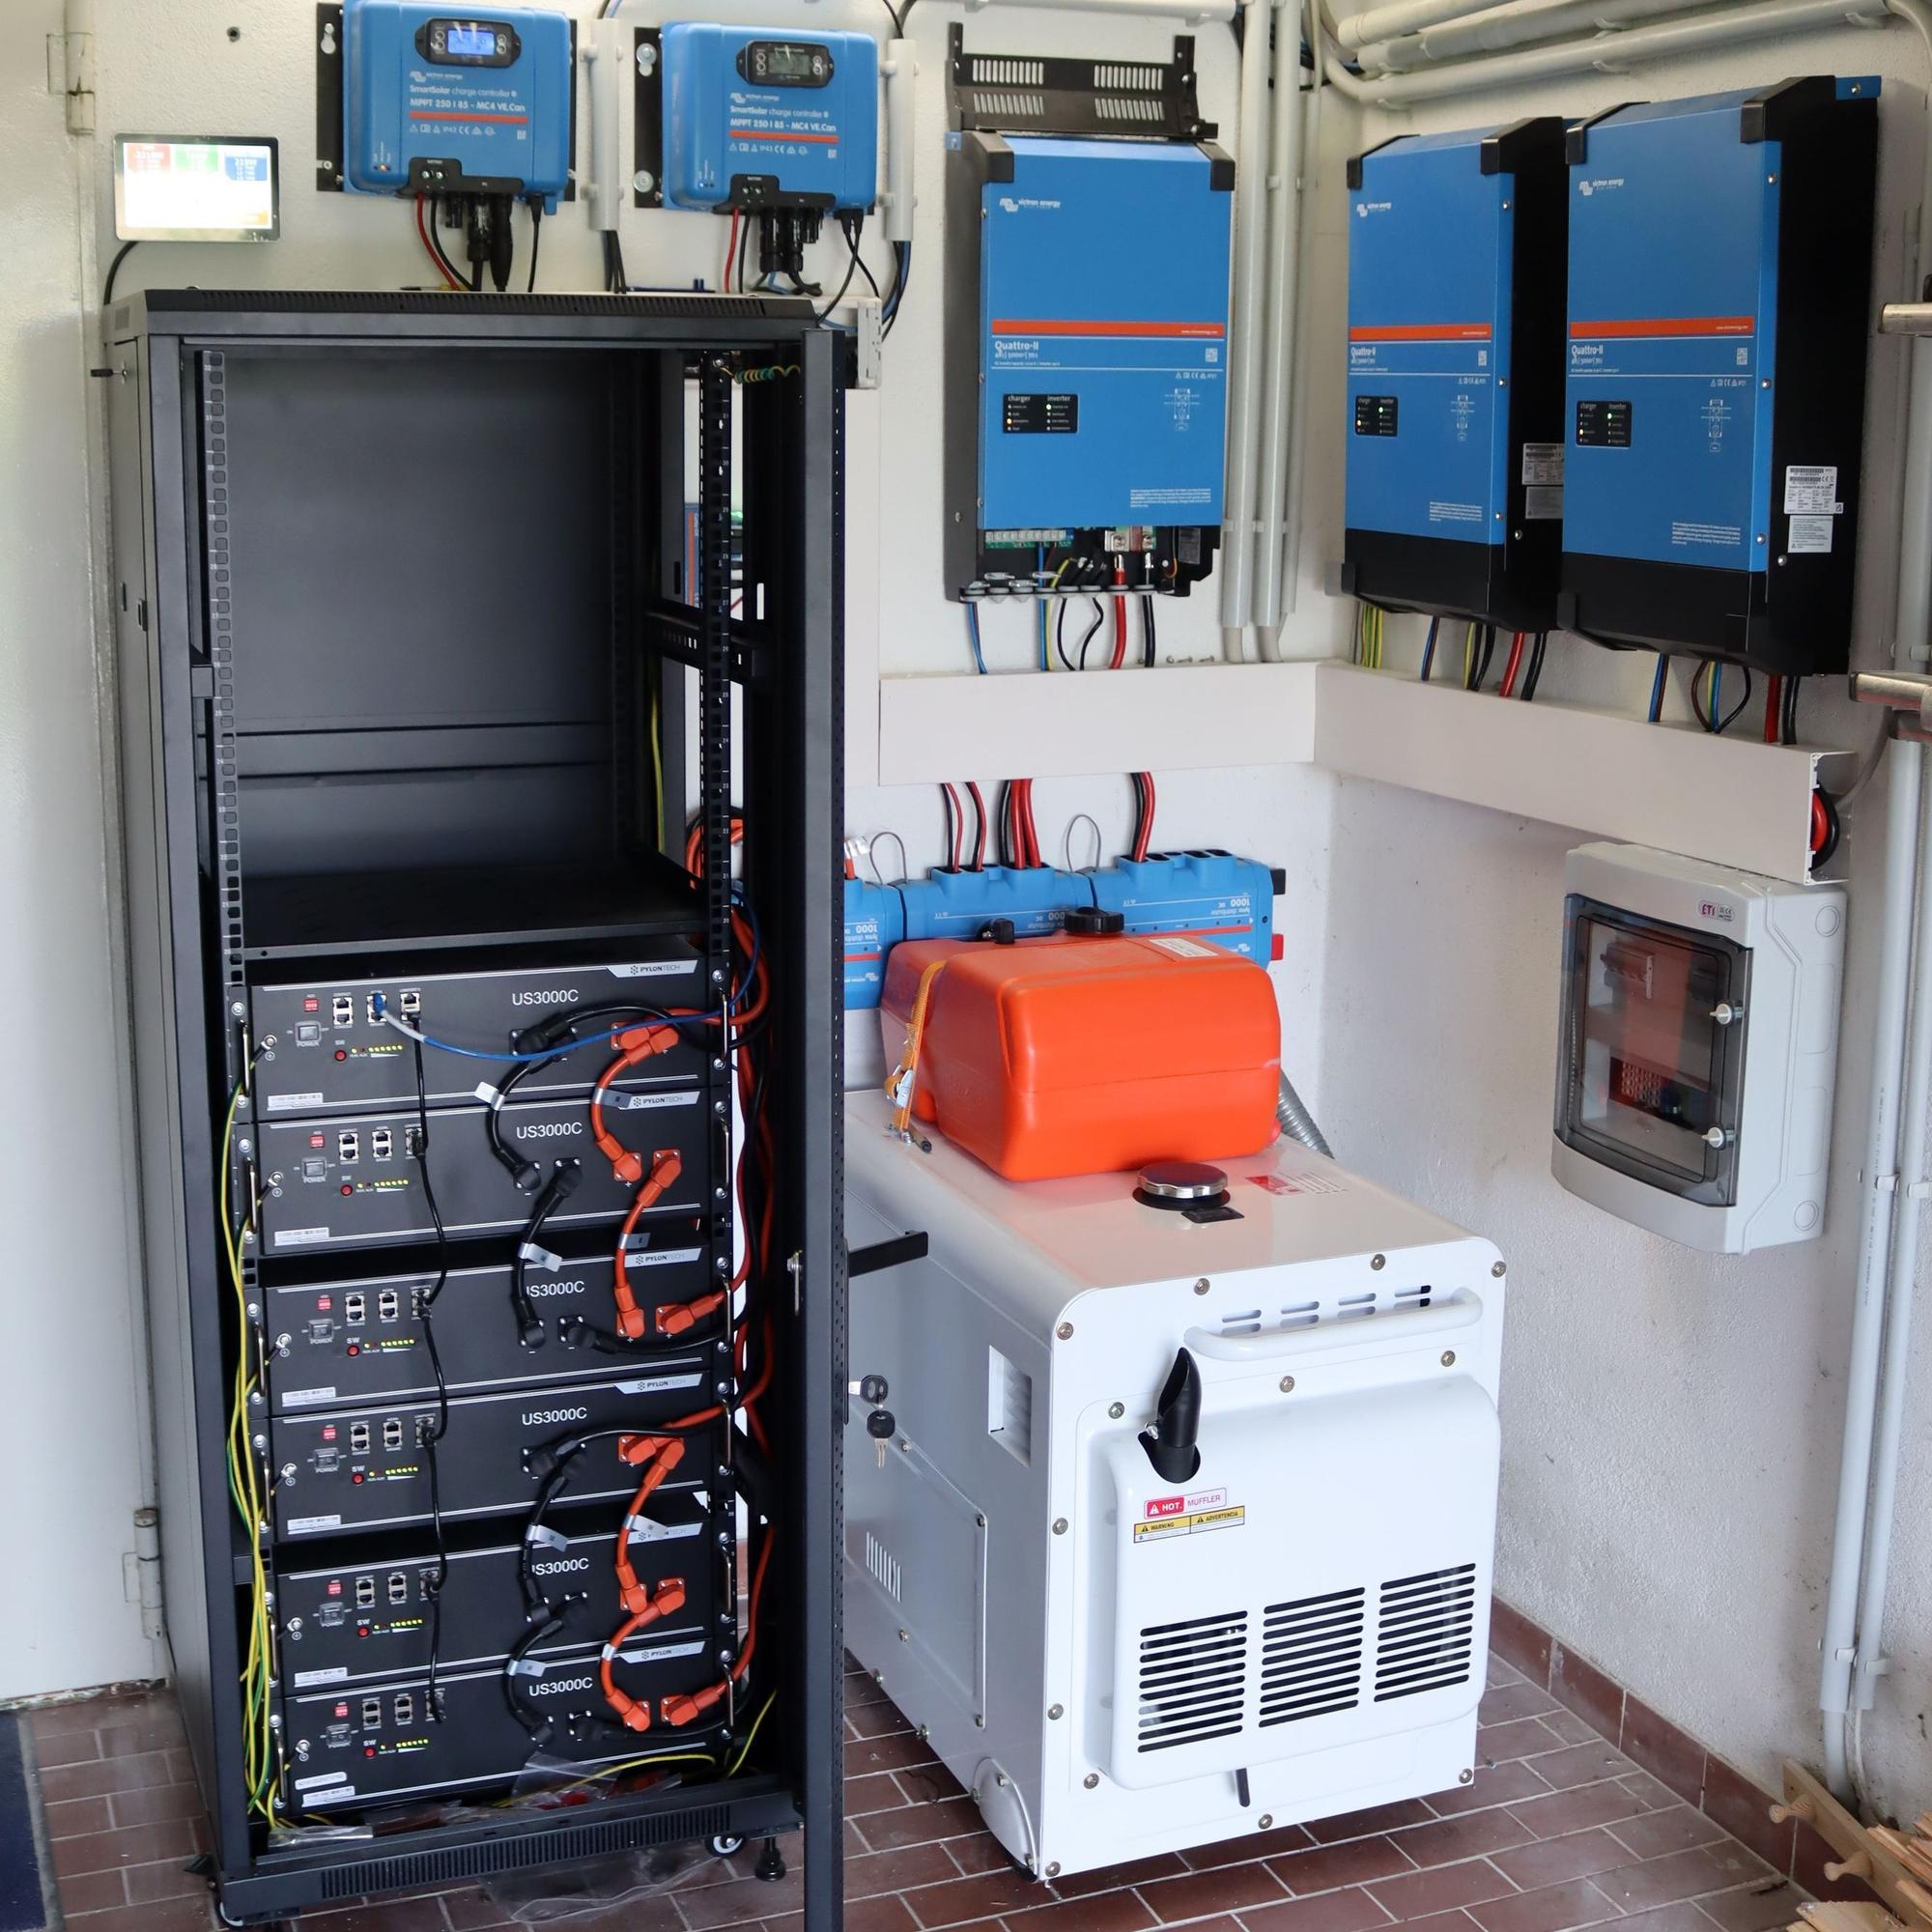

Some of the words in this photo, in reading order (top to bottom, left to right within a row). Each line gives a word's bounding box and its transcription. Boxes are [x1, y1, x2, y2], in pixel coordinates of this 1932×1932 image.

[410, 85, 450, 94] SmartSolar
[451, 87, 476, 97] charge
[477, 88, 510, 97] controller
[410, 98, 433, 107] MPPT
[436, 99, 451, 108] 250
[476, 101, 496, 110] MC4
[730, 105, 767, 114] SmartSolar
[768, 108, 791, 117] charge
[793, 109, 822, 118] controller
[730, 118, 752, 127] MPPT
[791, 122, 809, 130] MC4
[1231, 898, 1250, 908] 1000
[1702, 904, 1716, 916] ETI
[1048, 912, 1065, 921] 000
[856, 924, 877, 933] 1000
[639, 964, 681, 973] PYLONTECH
[512, 989, 580, 1006] US3000C
[642, 1095, 684, 1104] PYLONTECH
[516, 1122, 582, 1139] US3000C
[522, 1406, 588, 1426] US3000C
[1187, 1494, 1221, 1507] MUFFLER
[1206, 1512, 1238, 1521] ADVERTENCIA
[531, 1557, 589, 1576] S3000C
[528, 1677, 593, 1696] US3000C
